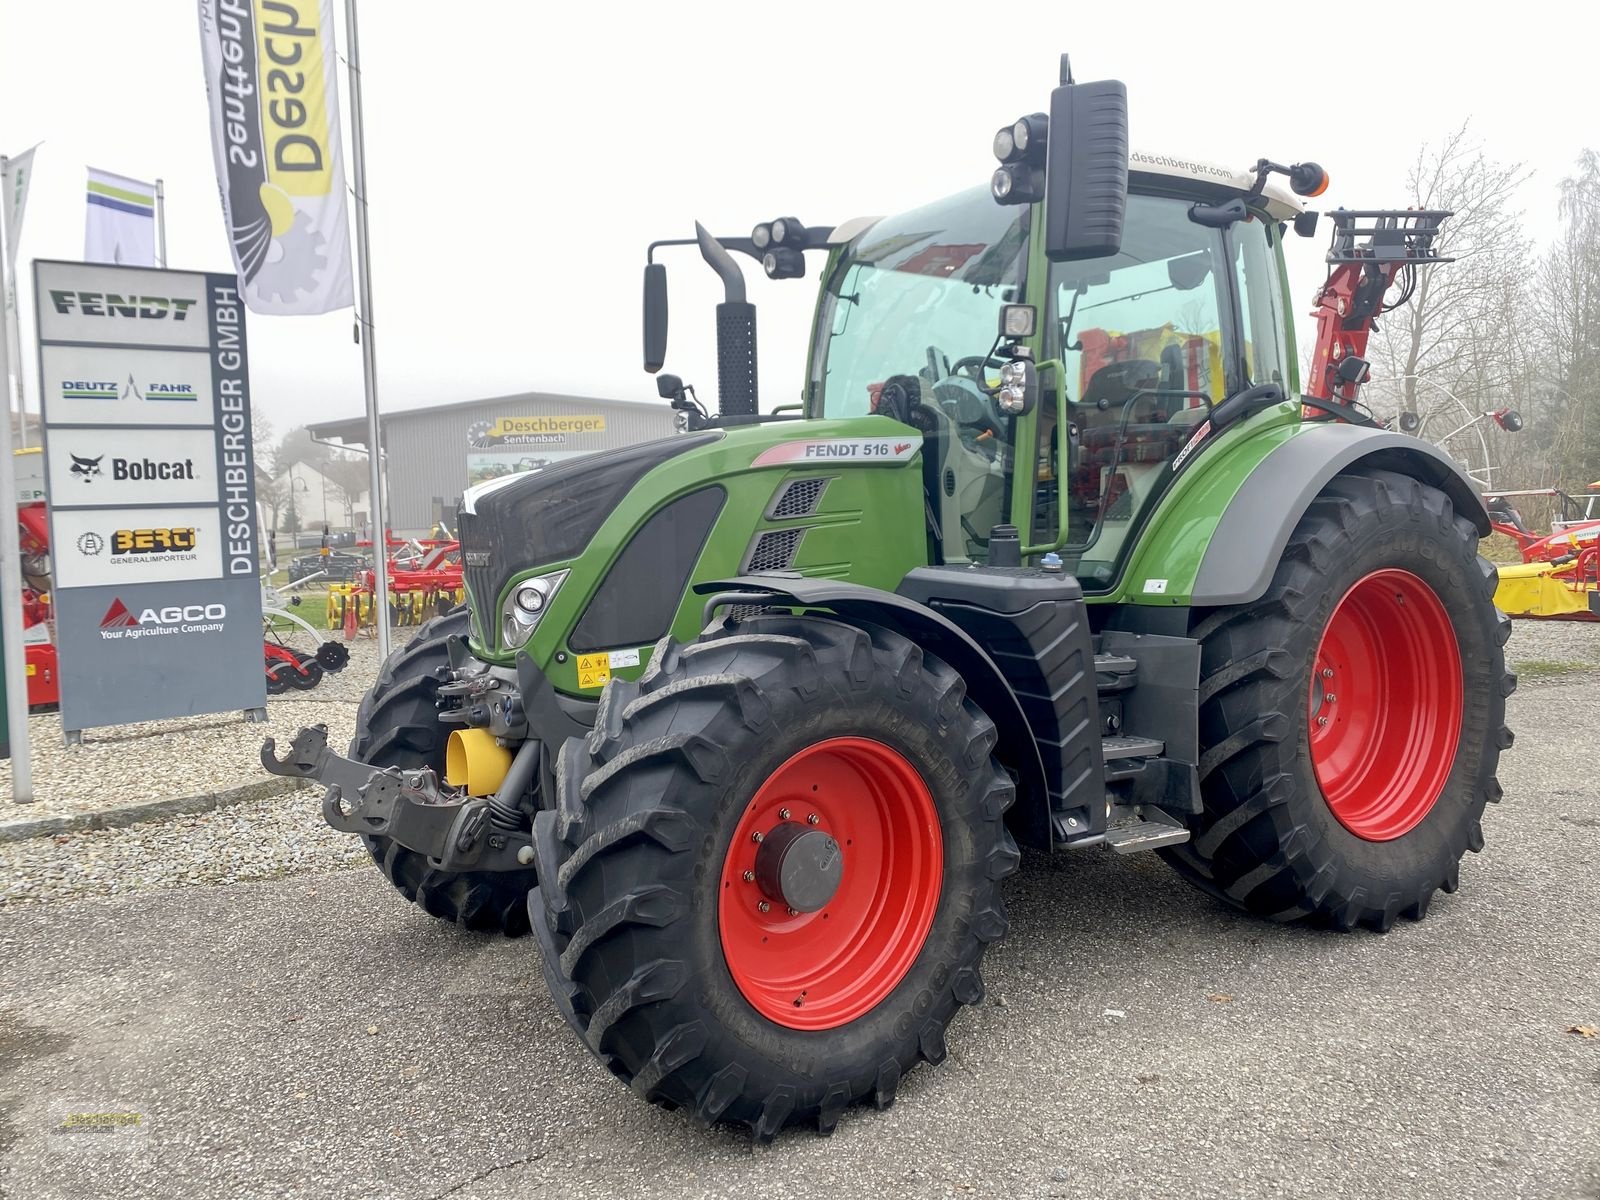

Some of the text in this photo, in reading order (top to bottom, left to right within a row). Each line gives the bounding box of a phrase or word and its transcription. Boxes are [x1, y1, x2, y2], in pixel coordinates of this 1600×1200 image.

[49, 289, 197, 321] FENDT
[62, 381, 192, 393] DEUTZ FAHR
[215, 287, 252, 575] DESCHBERGER GMBH
[503, 418, 600, 433] Deschberger
[503, 434, 566, 444] Senftenbach
[805, 444, 859, 457] FENDT
[863, 444, 889, 456] 516
[113, 458, 194, 481] Bobcat
[110, 554, 197, 564] GENERALIMPORTEUR
[138, 604, 226, 625] AGCO
[100, 622, 224, 640] Your Agriculture Company
